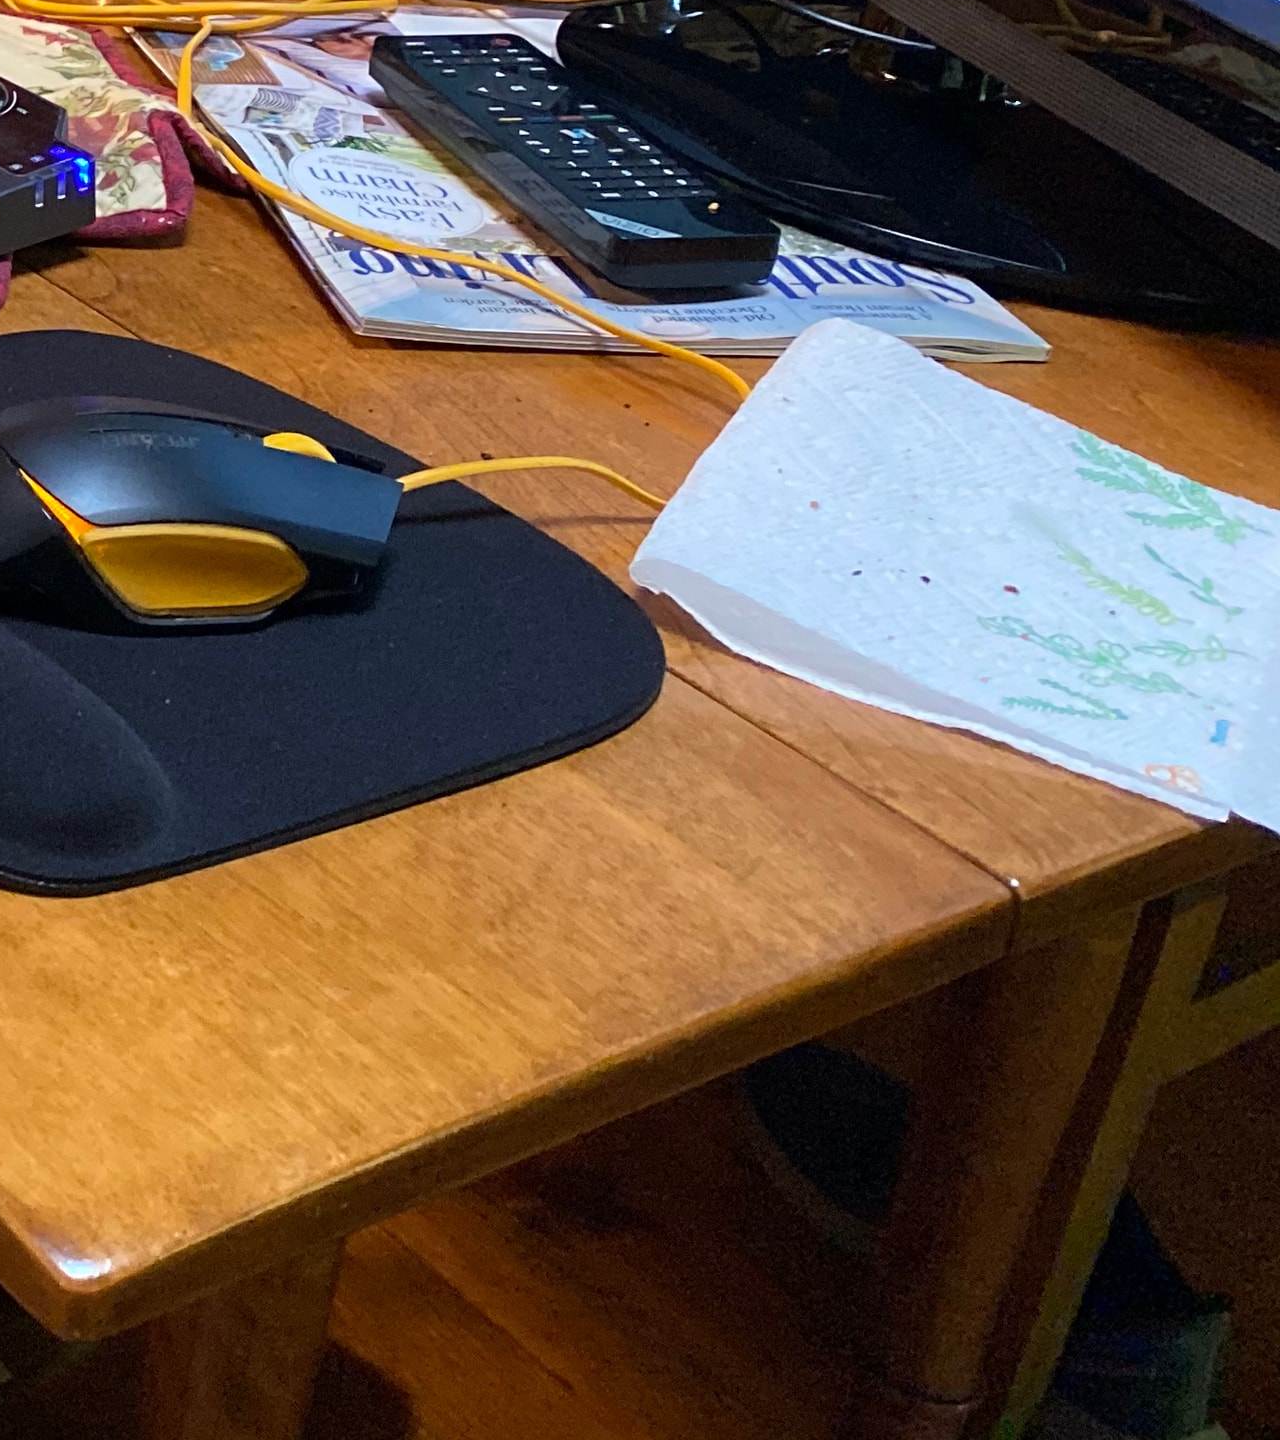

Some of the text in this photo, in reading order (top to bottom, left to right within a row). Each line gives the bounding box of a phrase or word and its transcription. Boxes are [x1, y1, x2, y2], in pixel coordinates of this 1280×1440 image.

[308, 166, 449, 200] Charm
[320, 186, 464, 212] Farmhouse
[357, 202, 456, 230] Easy
[602, 216, 660, 236] VIZIO
[751, 254, 976, 306] South
[651, 312, 776, 325] Old-Fashioned
[676, 303, 769, 315] Chocolate
[809, 302, 928, 314] Dream House
